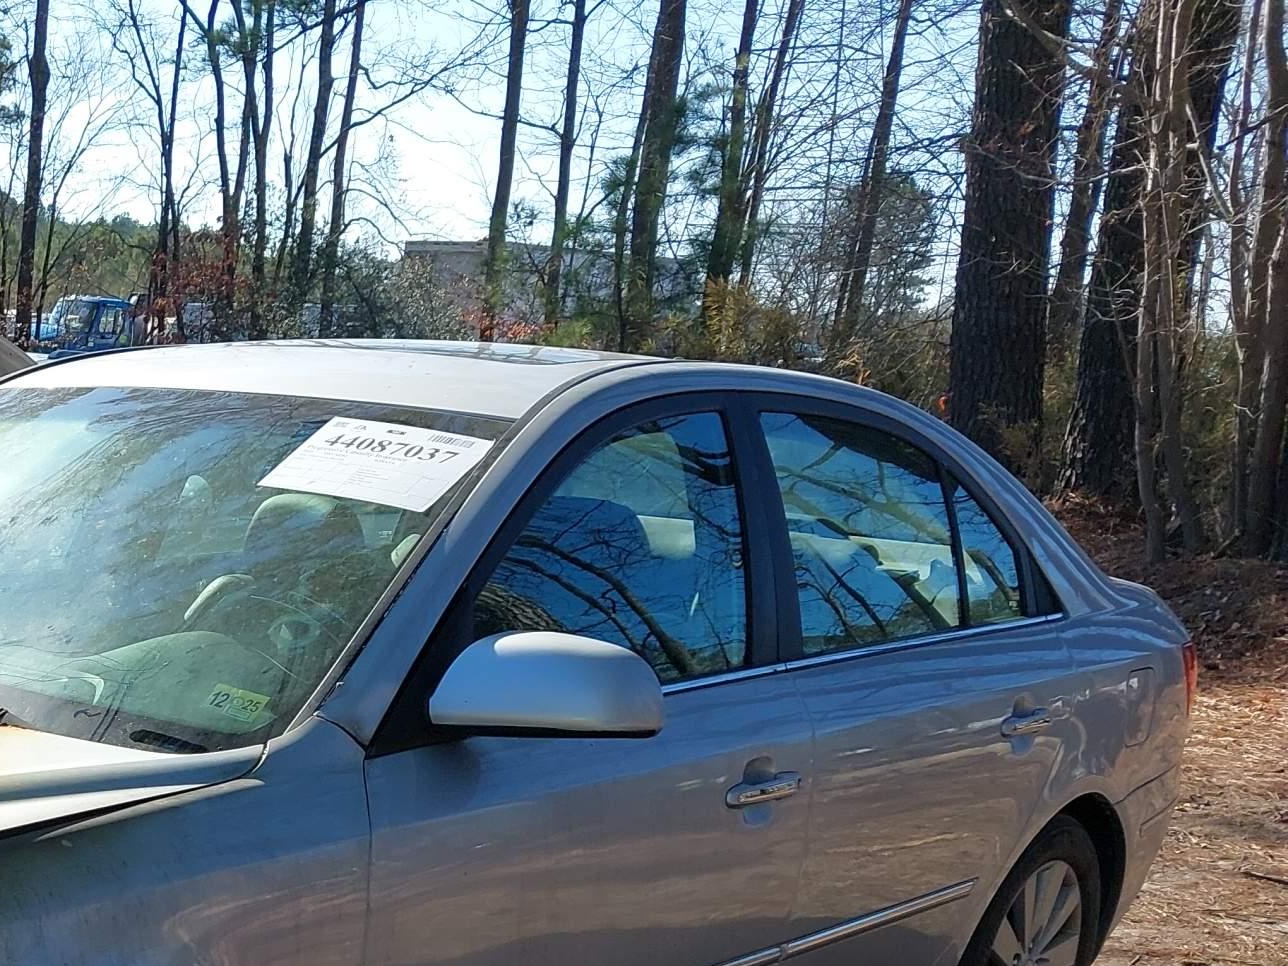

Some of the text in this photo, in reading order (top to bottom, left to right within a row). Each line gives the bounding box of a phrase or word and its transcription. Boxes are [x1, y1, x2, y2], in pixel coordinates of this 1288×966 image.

[324, 433, 460, 464] 44087037
[209, 691, 262, 713] 12 25
